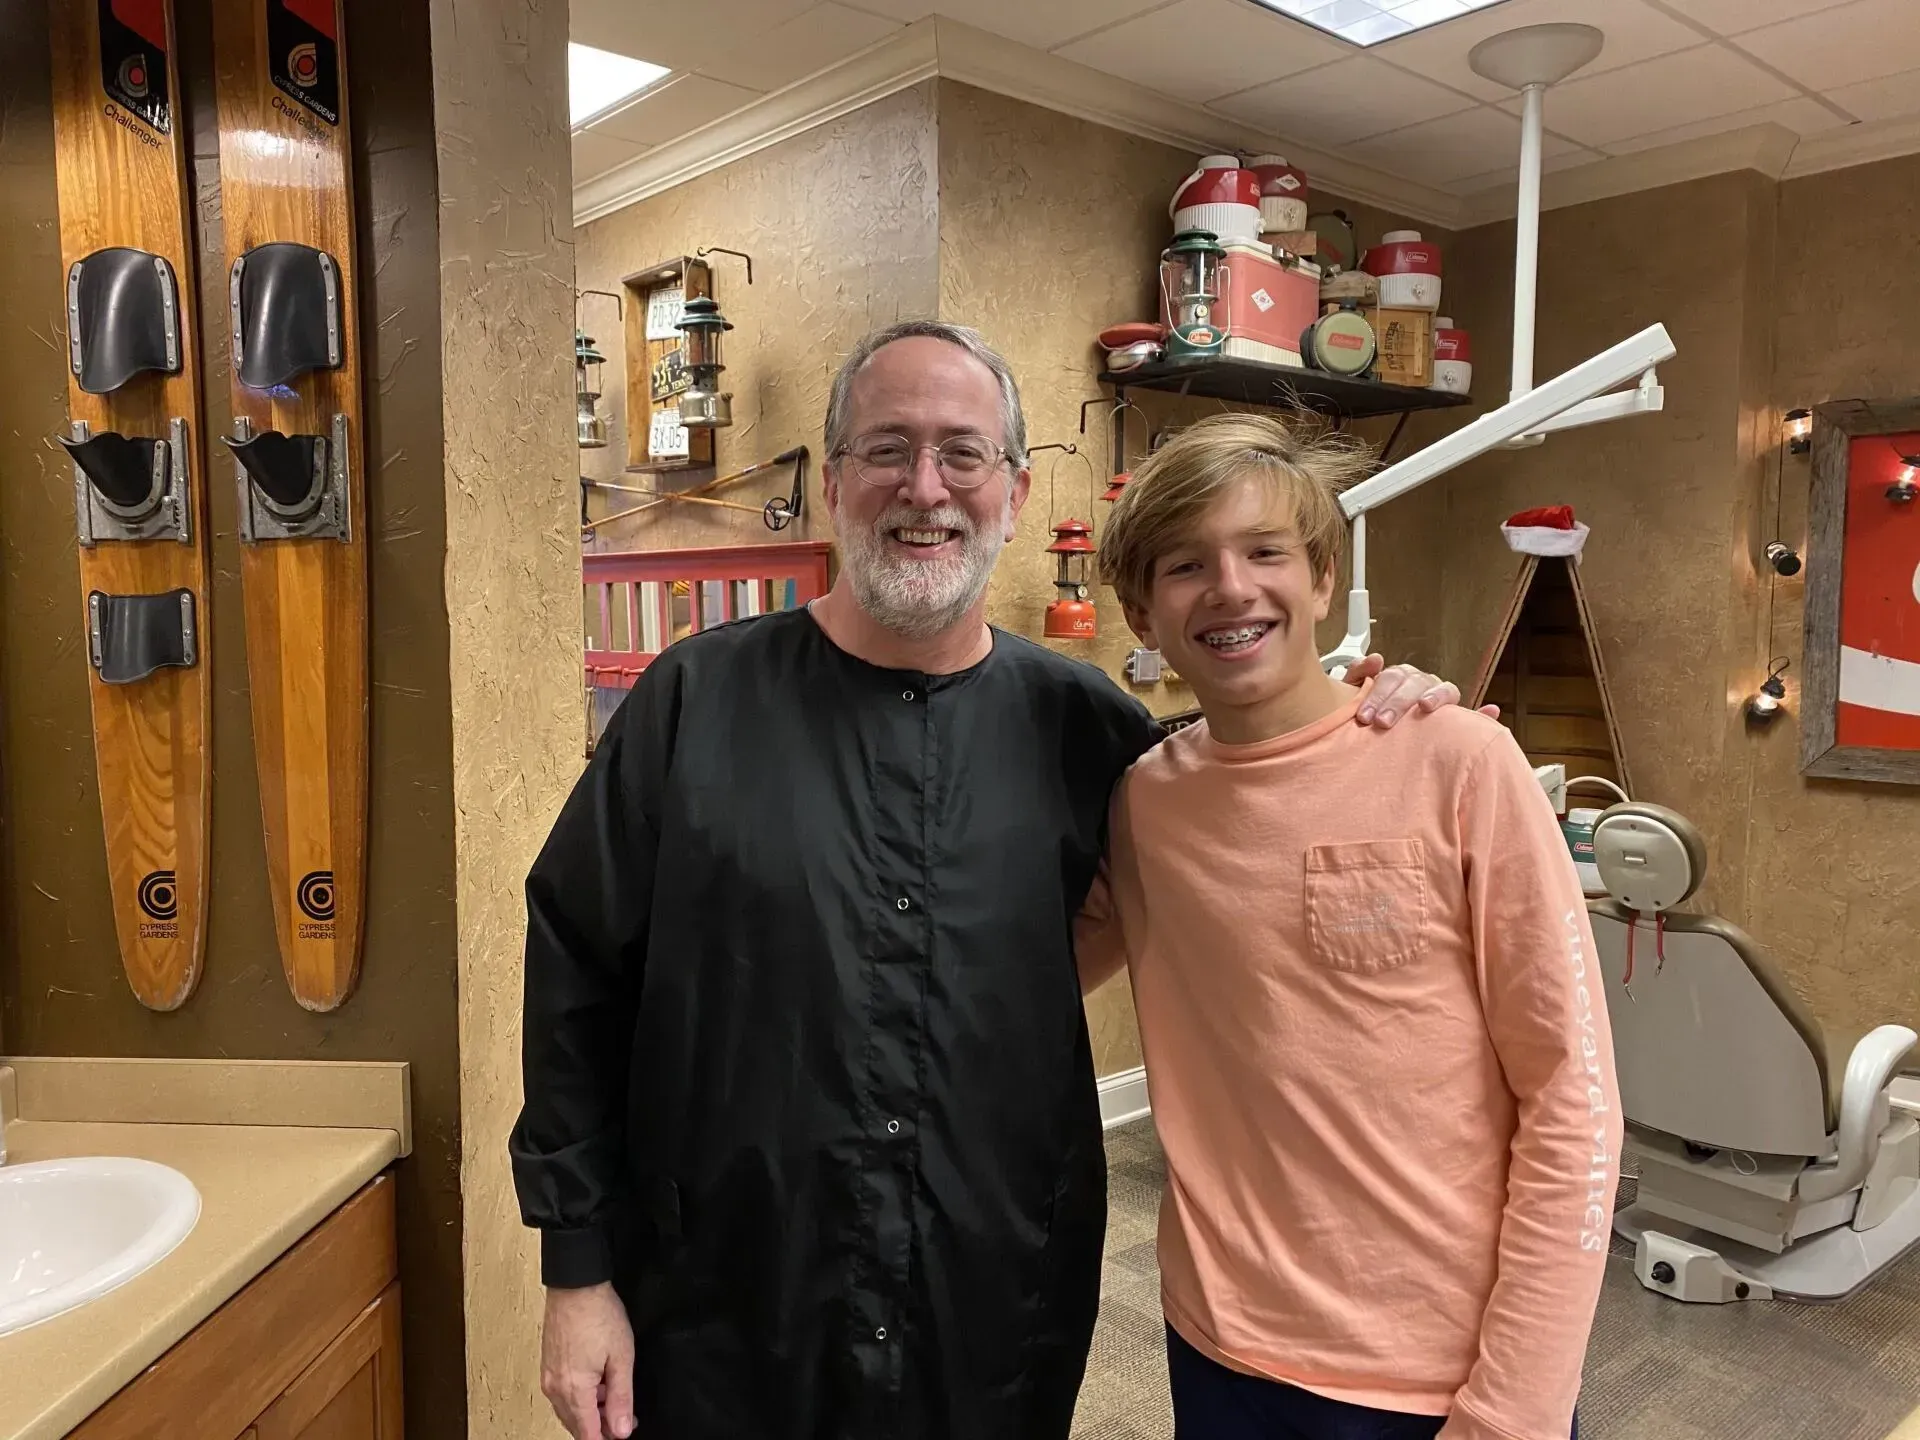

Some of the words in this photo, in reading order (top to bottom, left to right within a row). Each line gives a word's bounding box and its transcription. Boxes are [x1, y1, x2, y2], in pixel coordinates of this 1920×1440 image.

[274, 75, 305, 98] CYPRESS
[304, 96, 336, 121] GARDENS
[104, 103, 162, 149] Challenger
[140, 923, 178, 931] CYPRESS
[140, 931, 178, 939] GARDENS
[299, 923, 336, 931] CYPRESS
[299, 931, 337, 939] GARDENS
[1564, 908, 1609, 1117] vineyard
[1580, 1124, 1611, 1251] vines
